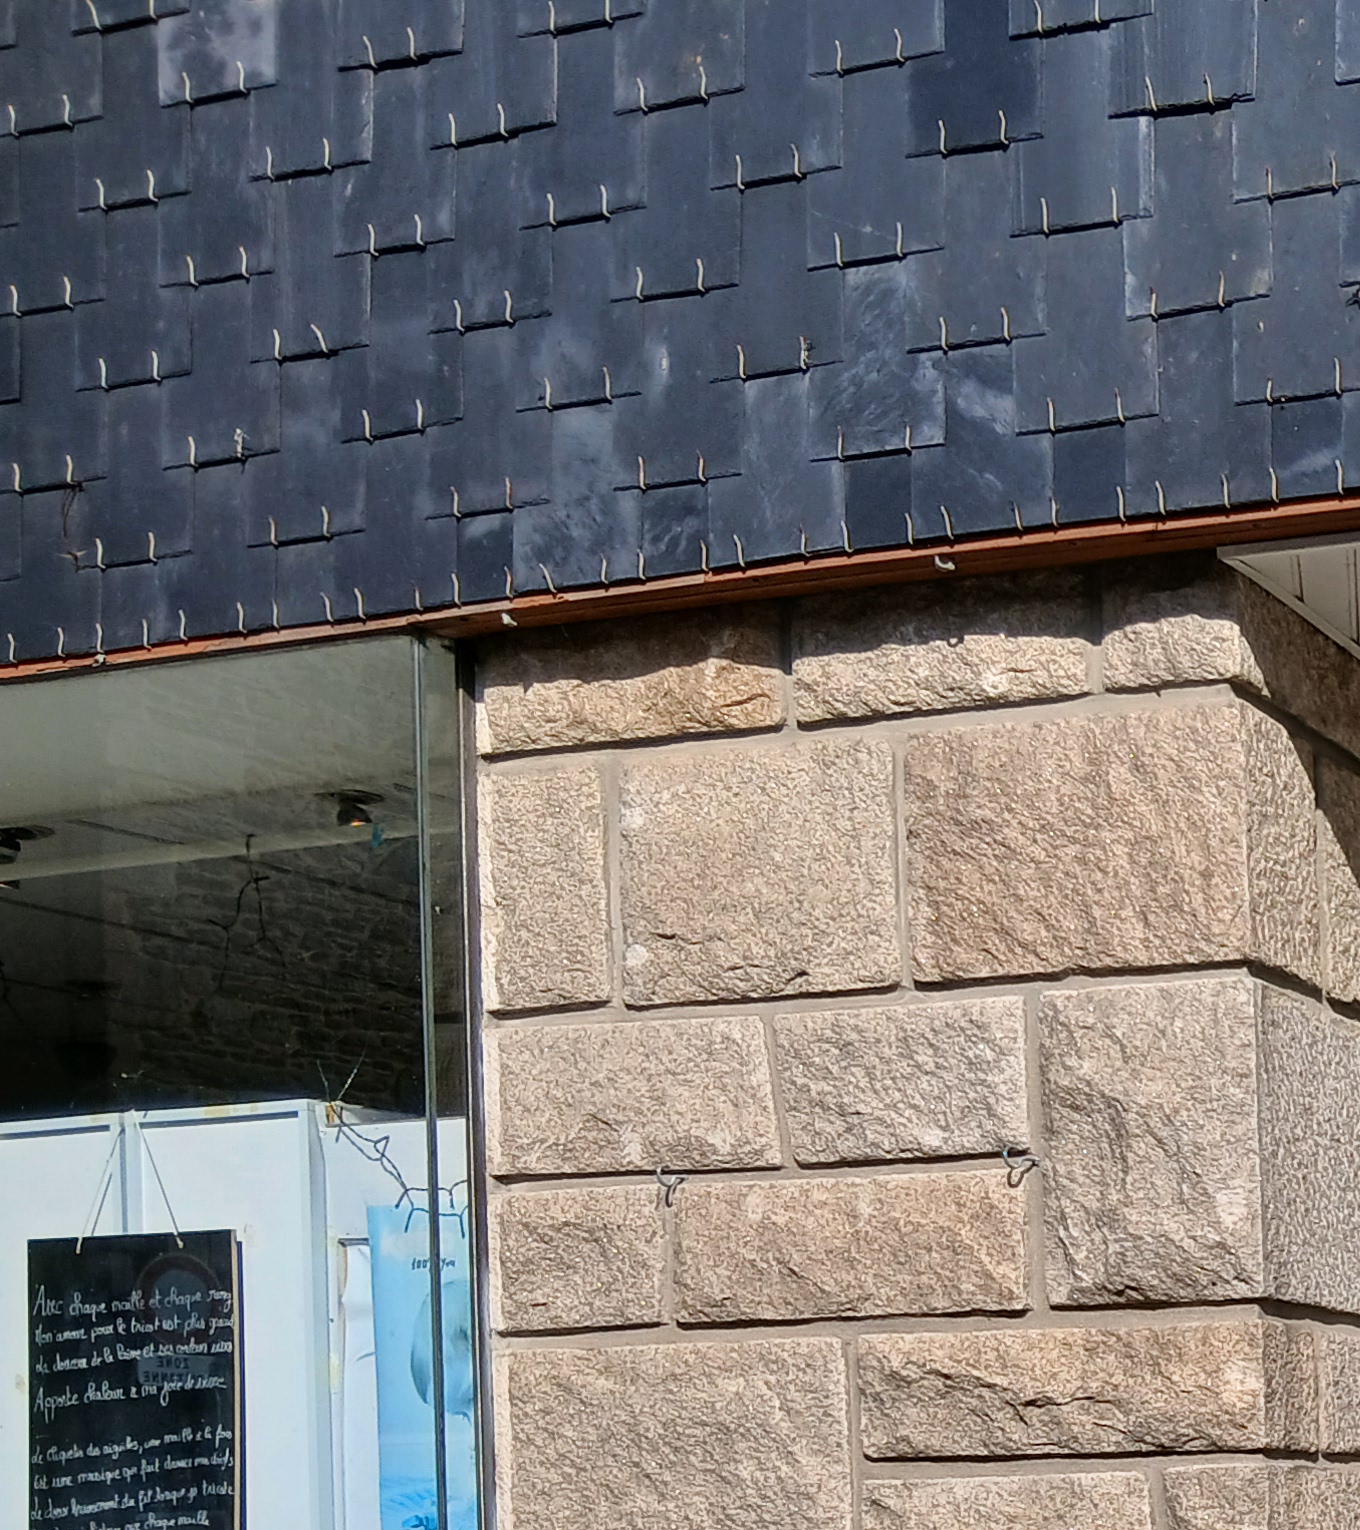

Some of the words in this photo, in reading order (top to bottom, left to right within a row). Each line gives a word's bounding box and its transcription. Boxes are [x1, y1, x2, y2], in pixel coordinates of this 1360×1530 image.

[33, 1284, 63, 1316] Avec
[69, 1291, 107, 1322] chaque
[111, 1288, 145, 1312] maille
[149, 1287, 161, 1309] et
[164, 1286, 202, 1311] chaque
[207, 1289, 232, 1313] rang
[91, 1324, 114, 1343] pour
[116, 1316, 126, 1335] le
[130, 1316, 160, 1333] tricot
[162, 1313, 181, 1331] est
[183, 1312, 205, 1337] plus
[143, 1342, 155, 1358] et
[34, 1386, 80, 1424] Apporte
[160, 1380, 183, 1407] joie
[31, 1445, 44, 1464] Le
[34, 1473, 49, 1490] Est
[140, 1458, 159, 1483] fait
[138, 1489, 153, 1512] fil
